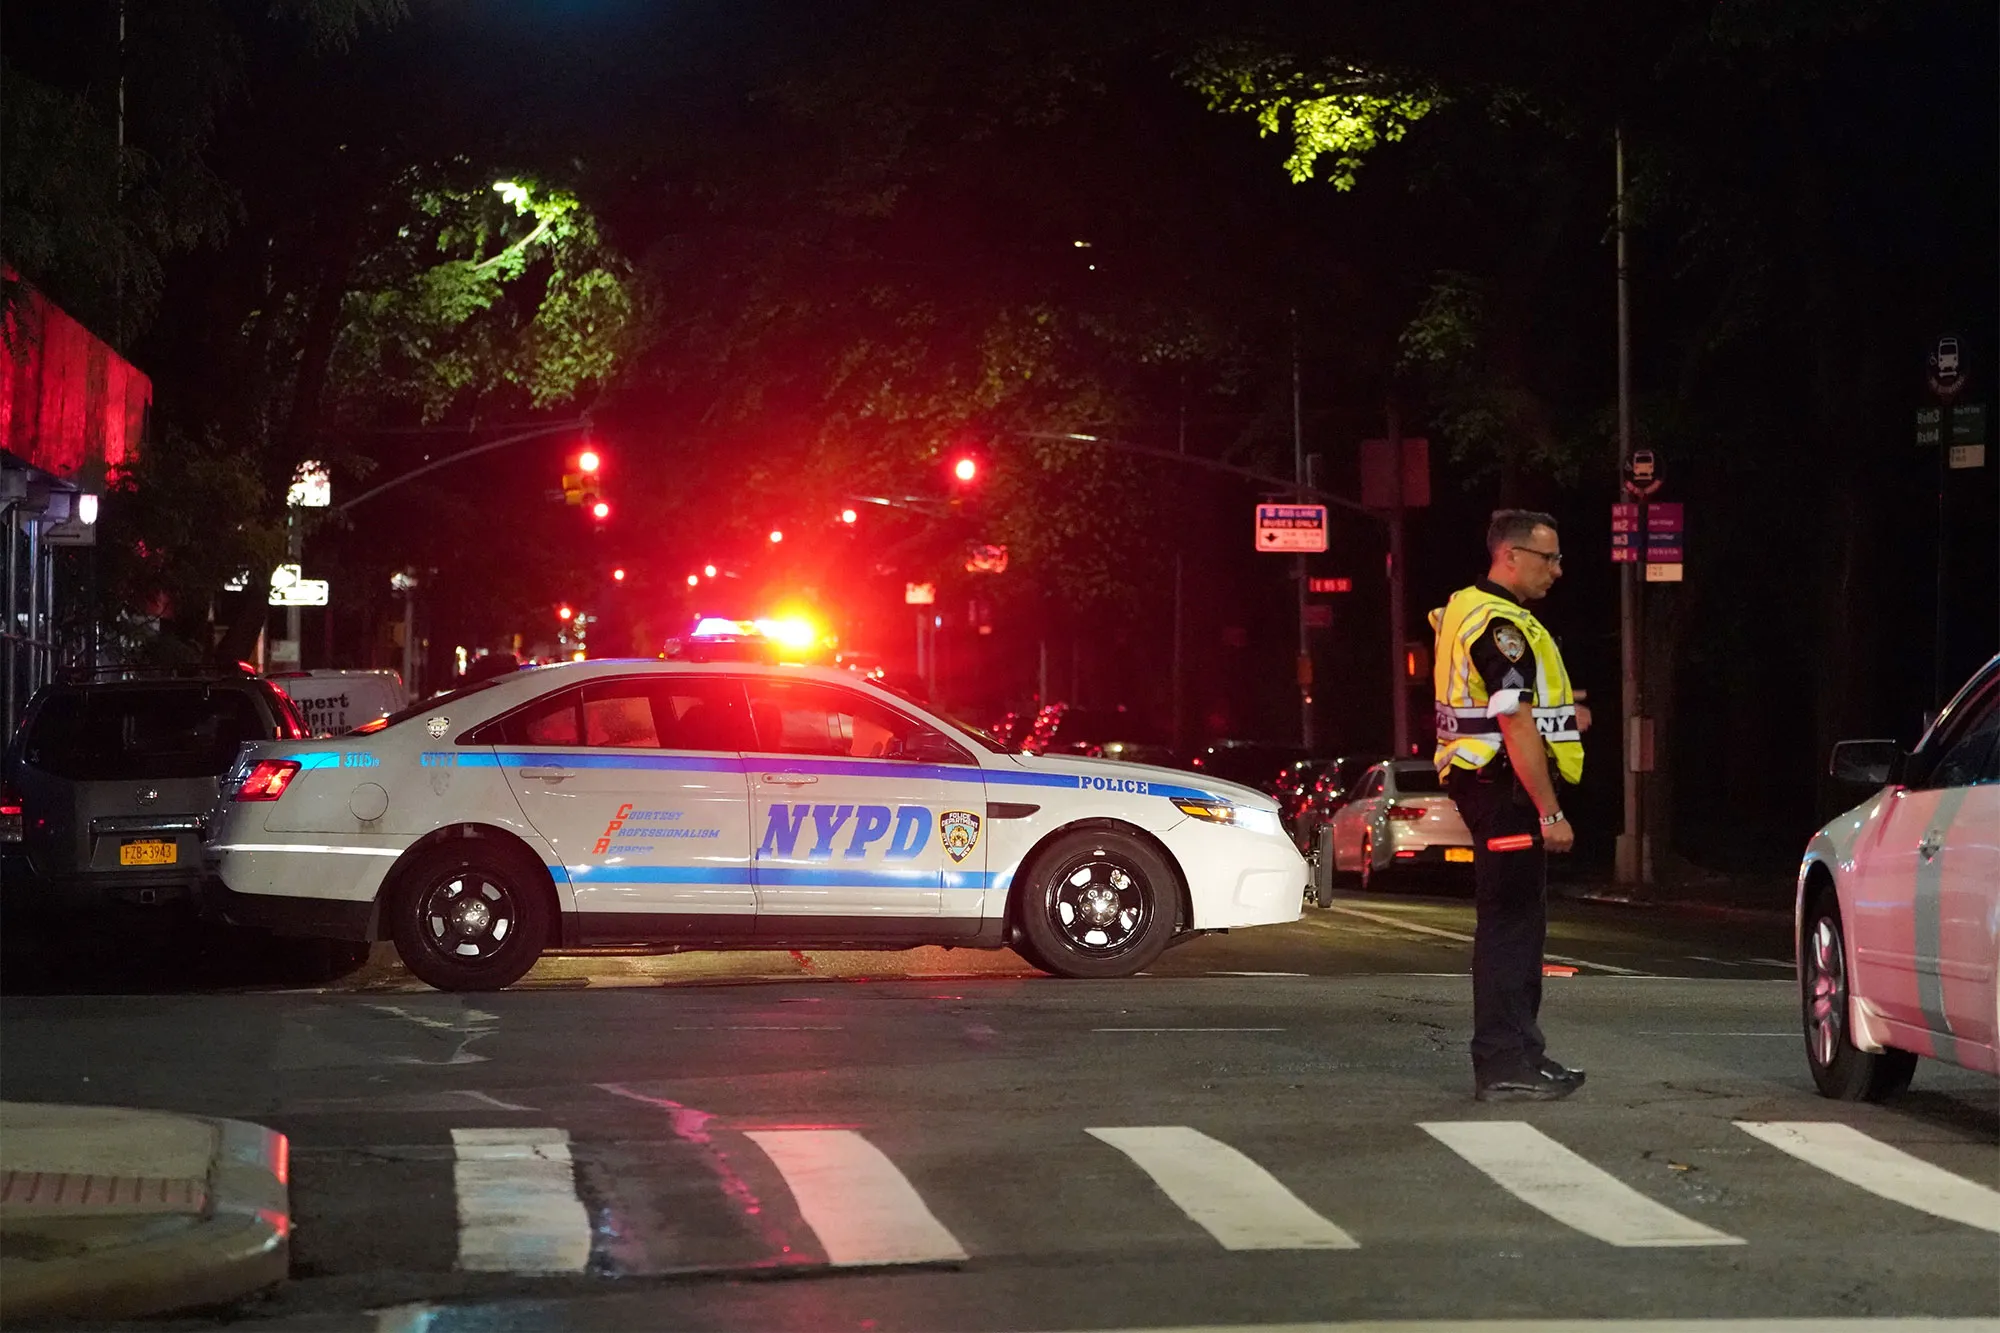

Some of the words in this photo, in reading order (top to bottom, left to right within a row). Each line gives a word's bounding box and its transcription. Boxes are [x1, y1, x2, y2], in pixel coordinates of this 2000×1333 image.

[1081, 776, 1147, 795] POLICE
[616, 803, 684, 821] COURTESY
[949, 812, 971, 821] POLICE
[604, 820, 720, 839] PROFESSIONALISM
[756, 804, 933, 861] NYPD
[941, 818, 979, 829] DEPARTMENT
